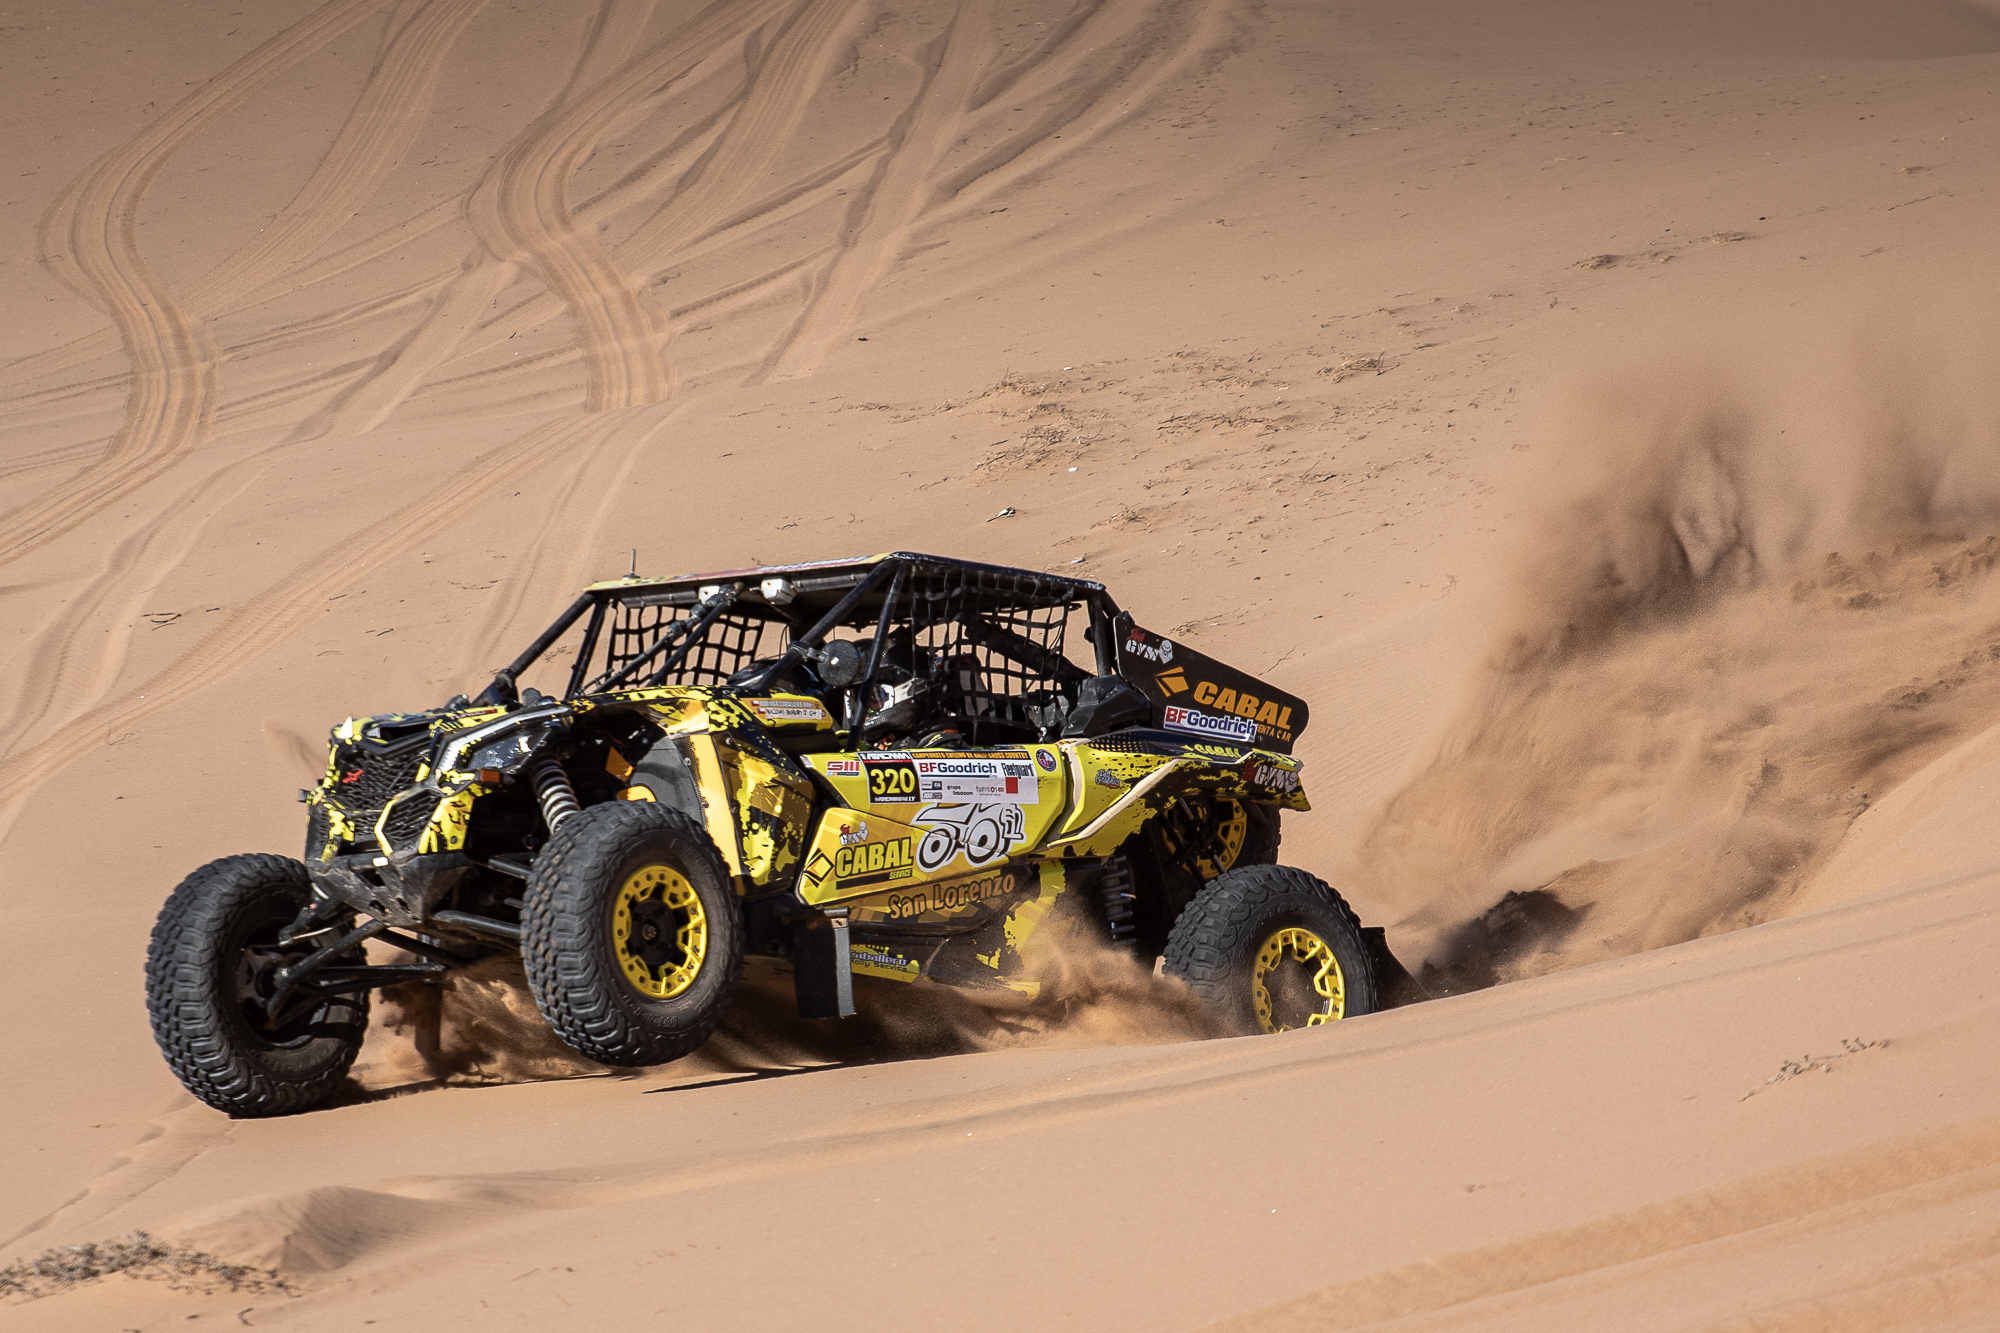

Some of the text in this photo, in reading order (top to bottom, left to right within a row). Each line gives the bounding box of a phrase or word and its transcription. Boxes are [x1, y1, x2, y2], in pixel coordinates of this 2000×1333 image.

[1193, 681, 1293, 730] CABAL
[1165, 707, 1256, 737] BFGoodrich
[1276, 729, 1293, 743] CAR
[870, 768, 915, 795] 320
[919, 762, 997, 774] BFGoodrich
[835, 837, 913, 878] CABAL
[889, 868, 912, 880] SERVICE
[889, 873, 1015, 919] San Lorenzo
